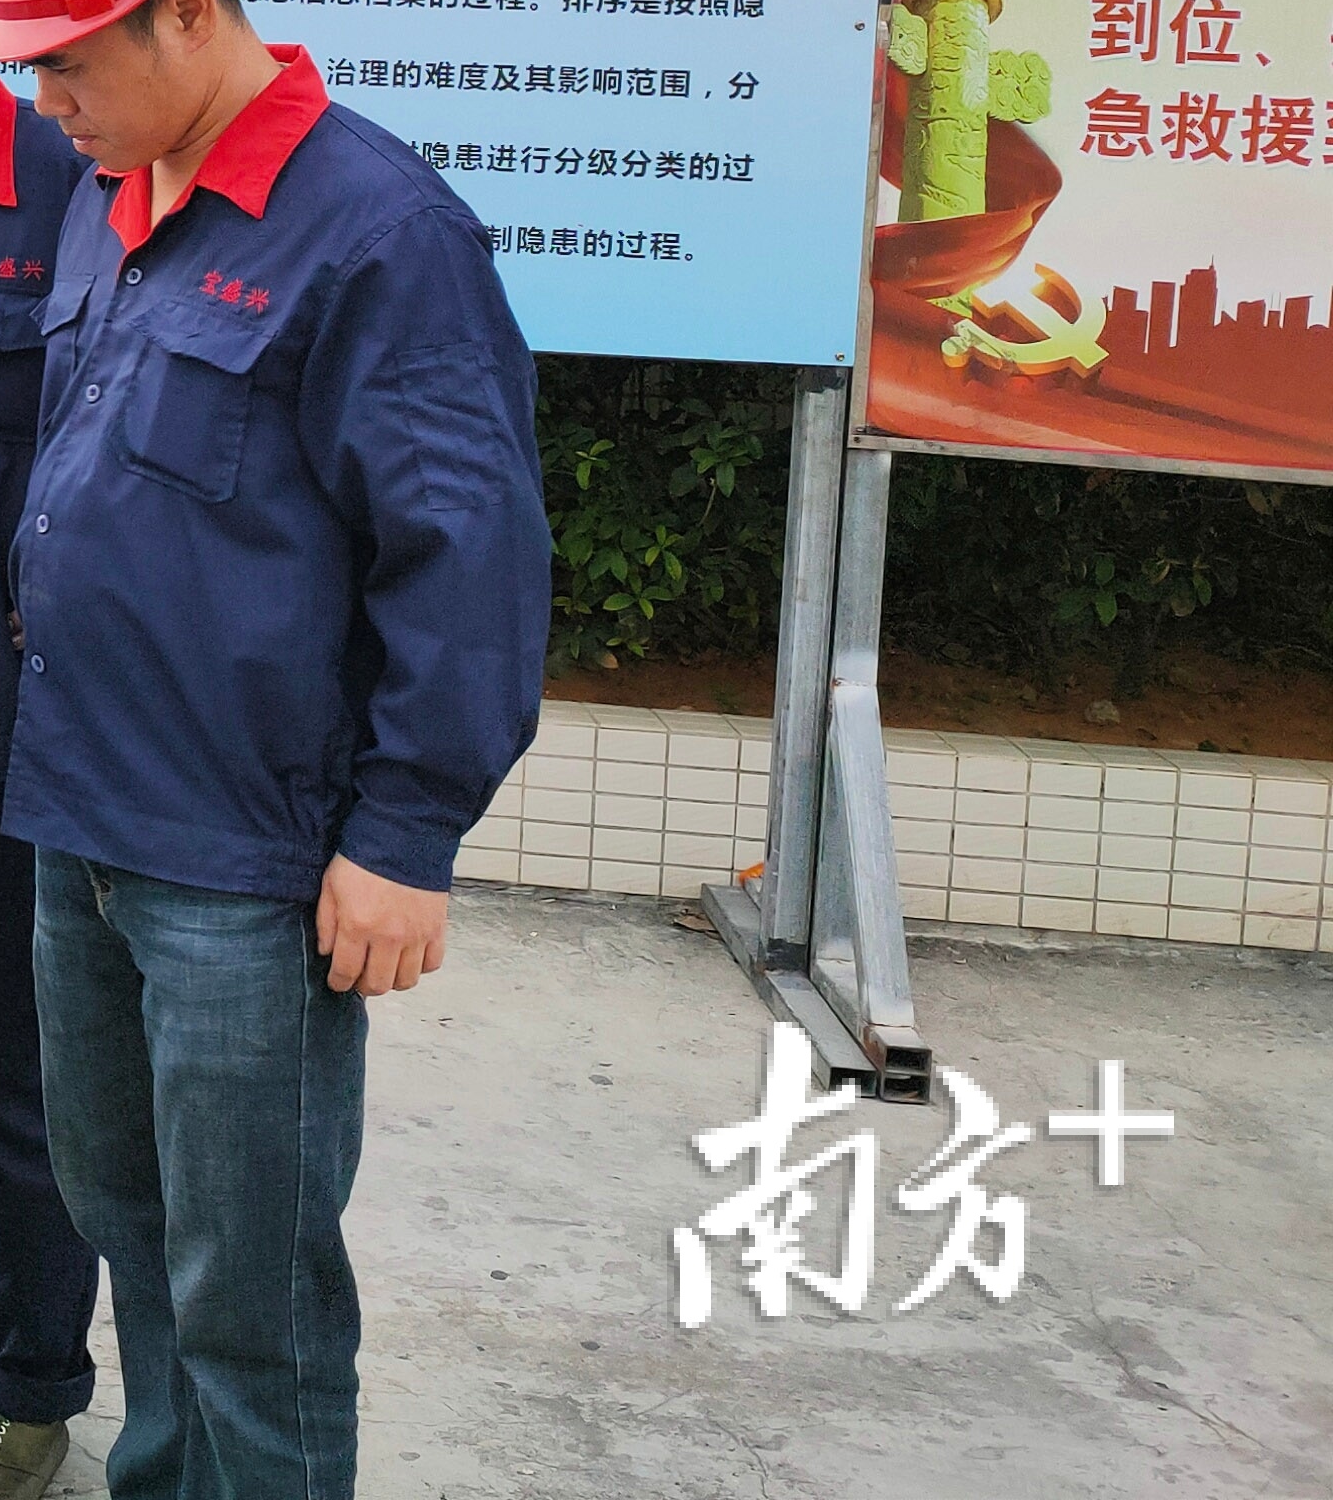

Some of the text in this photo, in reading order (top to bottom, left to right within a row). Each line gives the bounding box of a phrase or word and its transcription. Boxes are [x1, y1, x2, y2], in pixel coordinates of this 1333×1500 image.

[326, 57, 761, 100] 治理的难度及其影响范围，分
[1079, 88, 1333, 167] 急救援
[408, 140, 756, 183] 隐患进行分级分类的过
[199, 269, 270, 315] 宝盛兴
